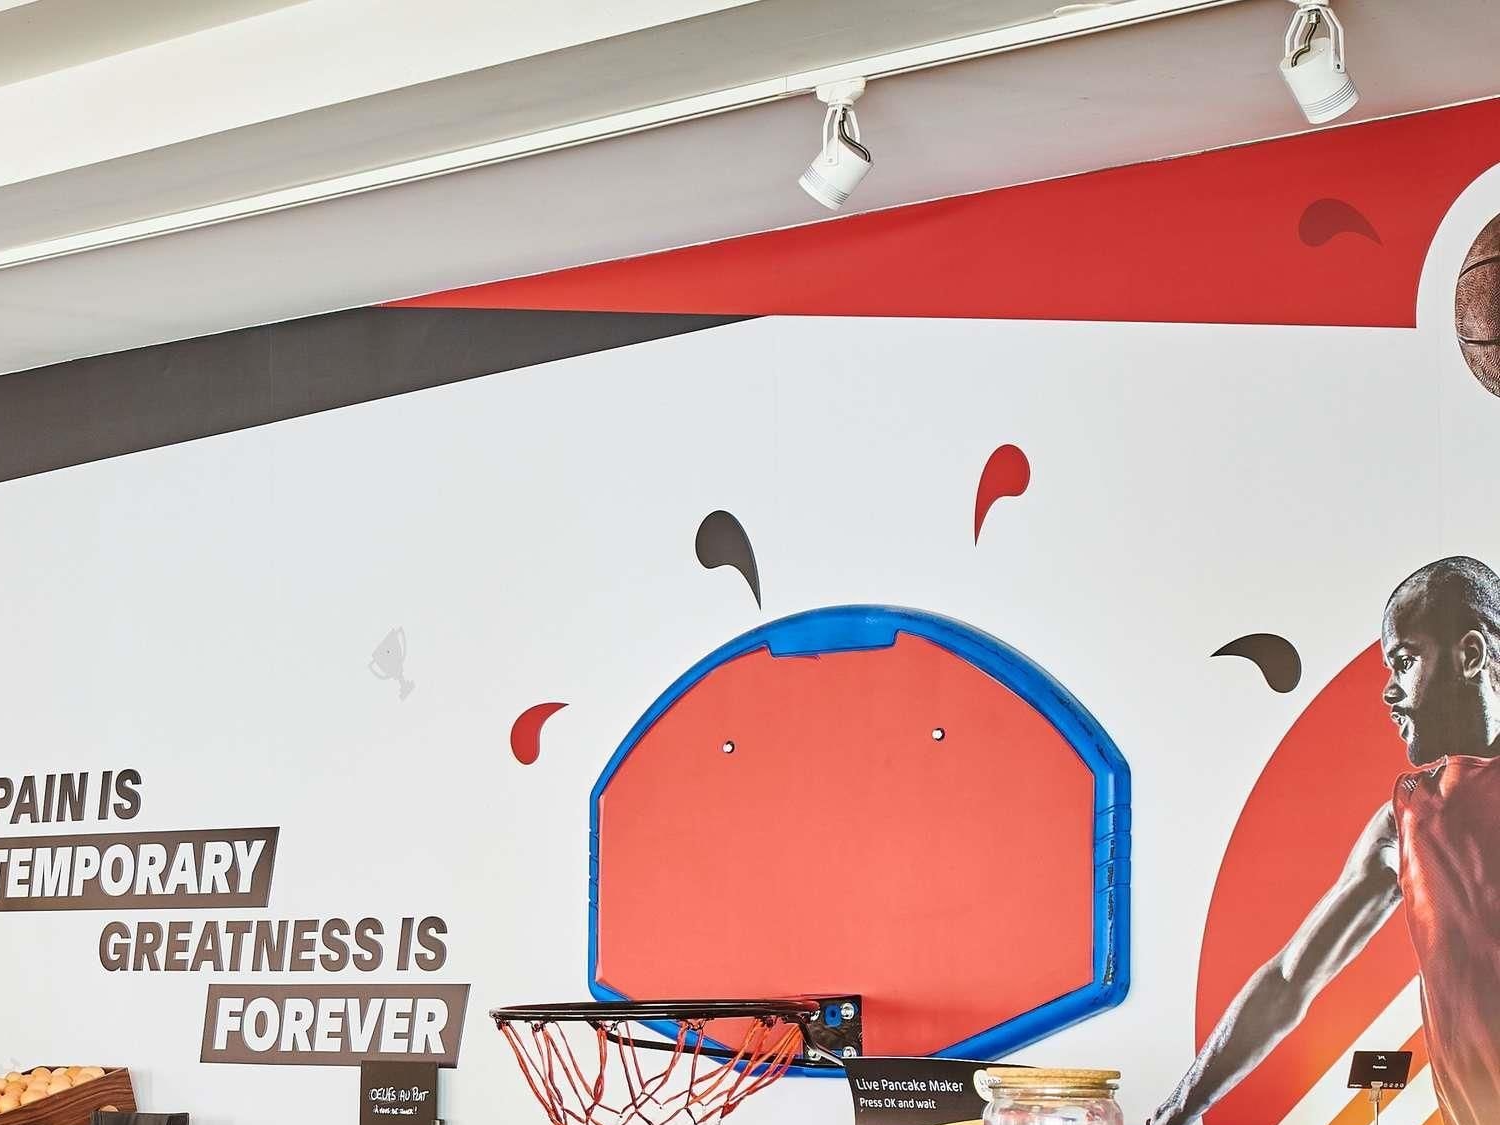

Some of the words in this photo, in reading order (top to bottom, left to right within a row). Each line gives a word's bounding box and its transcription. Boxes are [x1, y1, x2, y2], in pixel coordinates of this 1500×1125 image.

[96, 768, 143, 820] IS
[98, 917, 385, 972] GREATNESS
[395, 915, 448, 972] IS
[212, 996, 449, 1054] FOREVER
[399, 1089, 411, 1102] AU
[855, 1077, 880, 1091] Live
[882, 1078, 927, 1092] Pancake
[929, 1080, 964, 1093] Maker
[859, 1097, 883, 1108] Press
[884, 1098, 897, 1108] OK
[897, 1098, 915, 1109] and
[916, 1099, 937, 1110] wait
